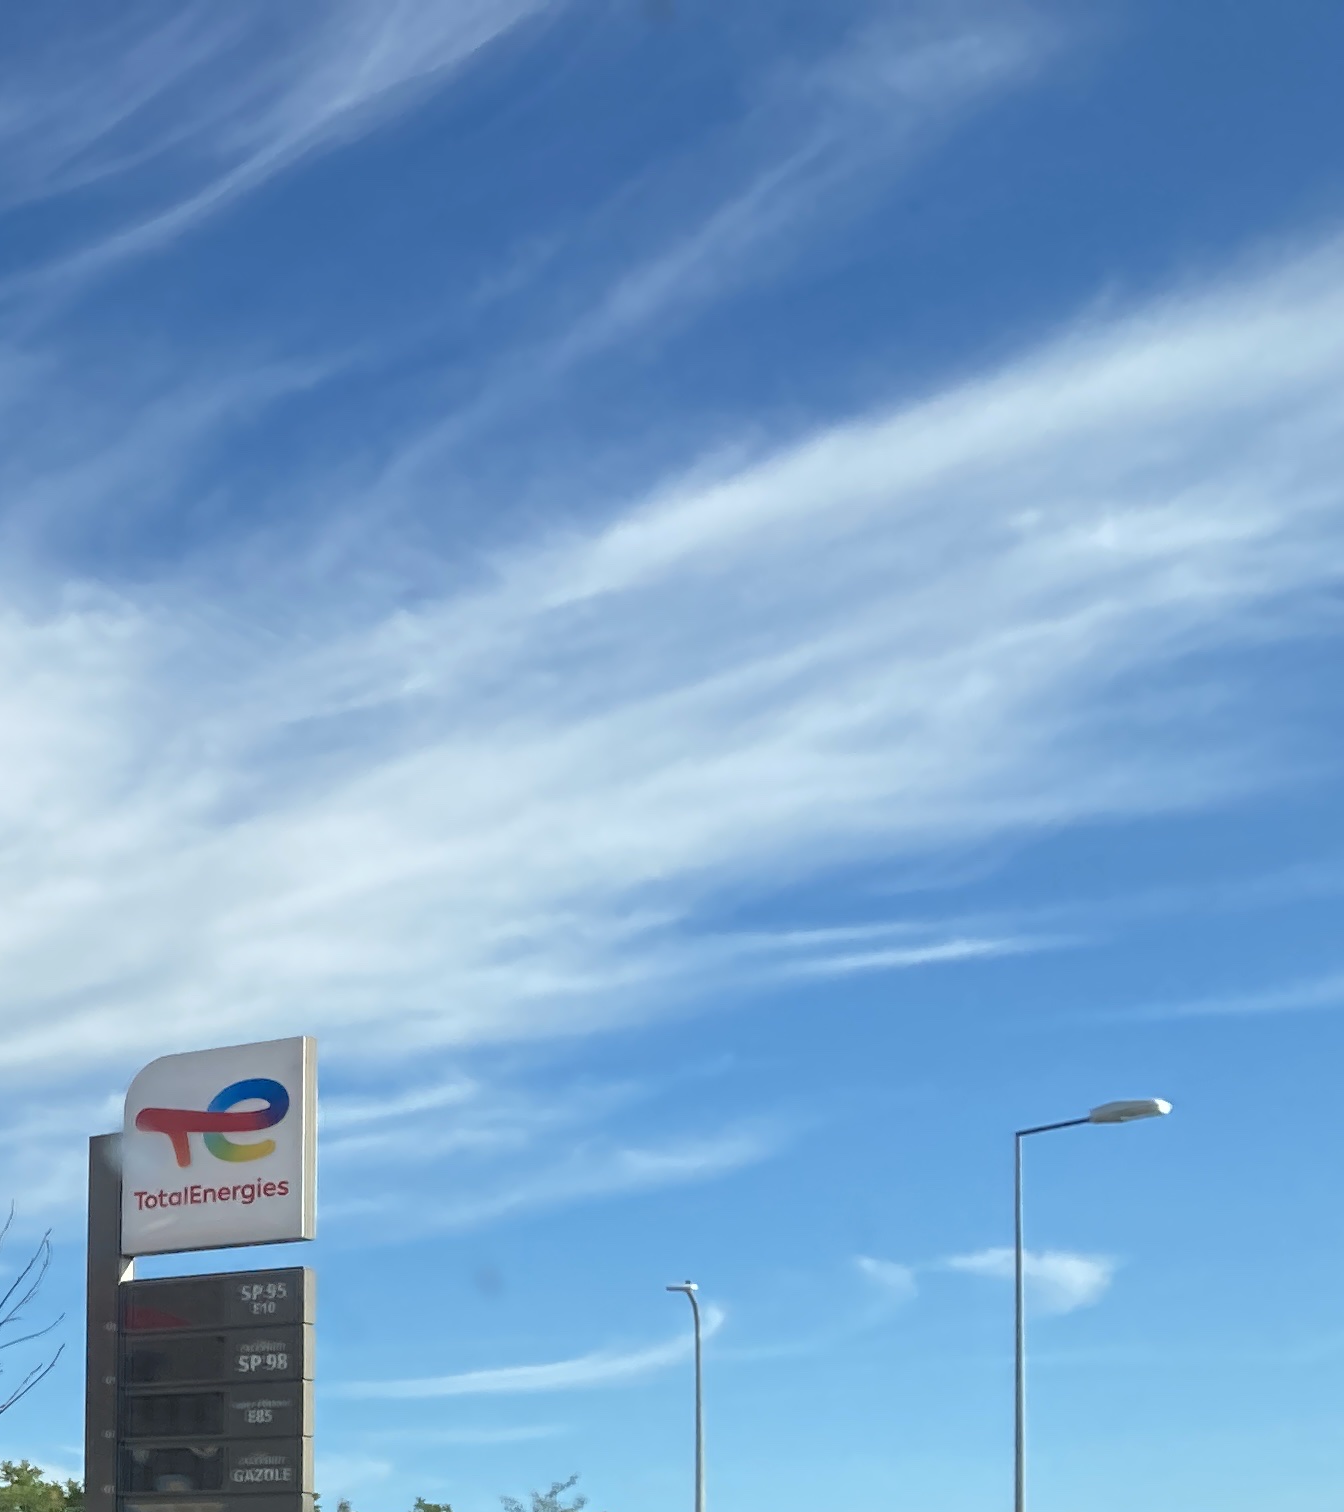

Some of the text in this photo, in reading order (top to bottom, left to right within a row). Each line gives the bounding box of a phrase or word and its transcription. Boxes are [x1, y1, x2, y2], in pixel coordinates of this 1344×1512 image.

[134, 1178, 289, 1210] TotalEnergies
[238, 1353, 288, 1372] SP 98
[232, 1468, 291, 1482] GAZOLE
